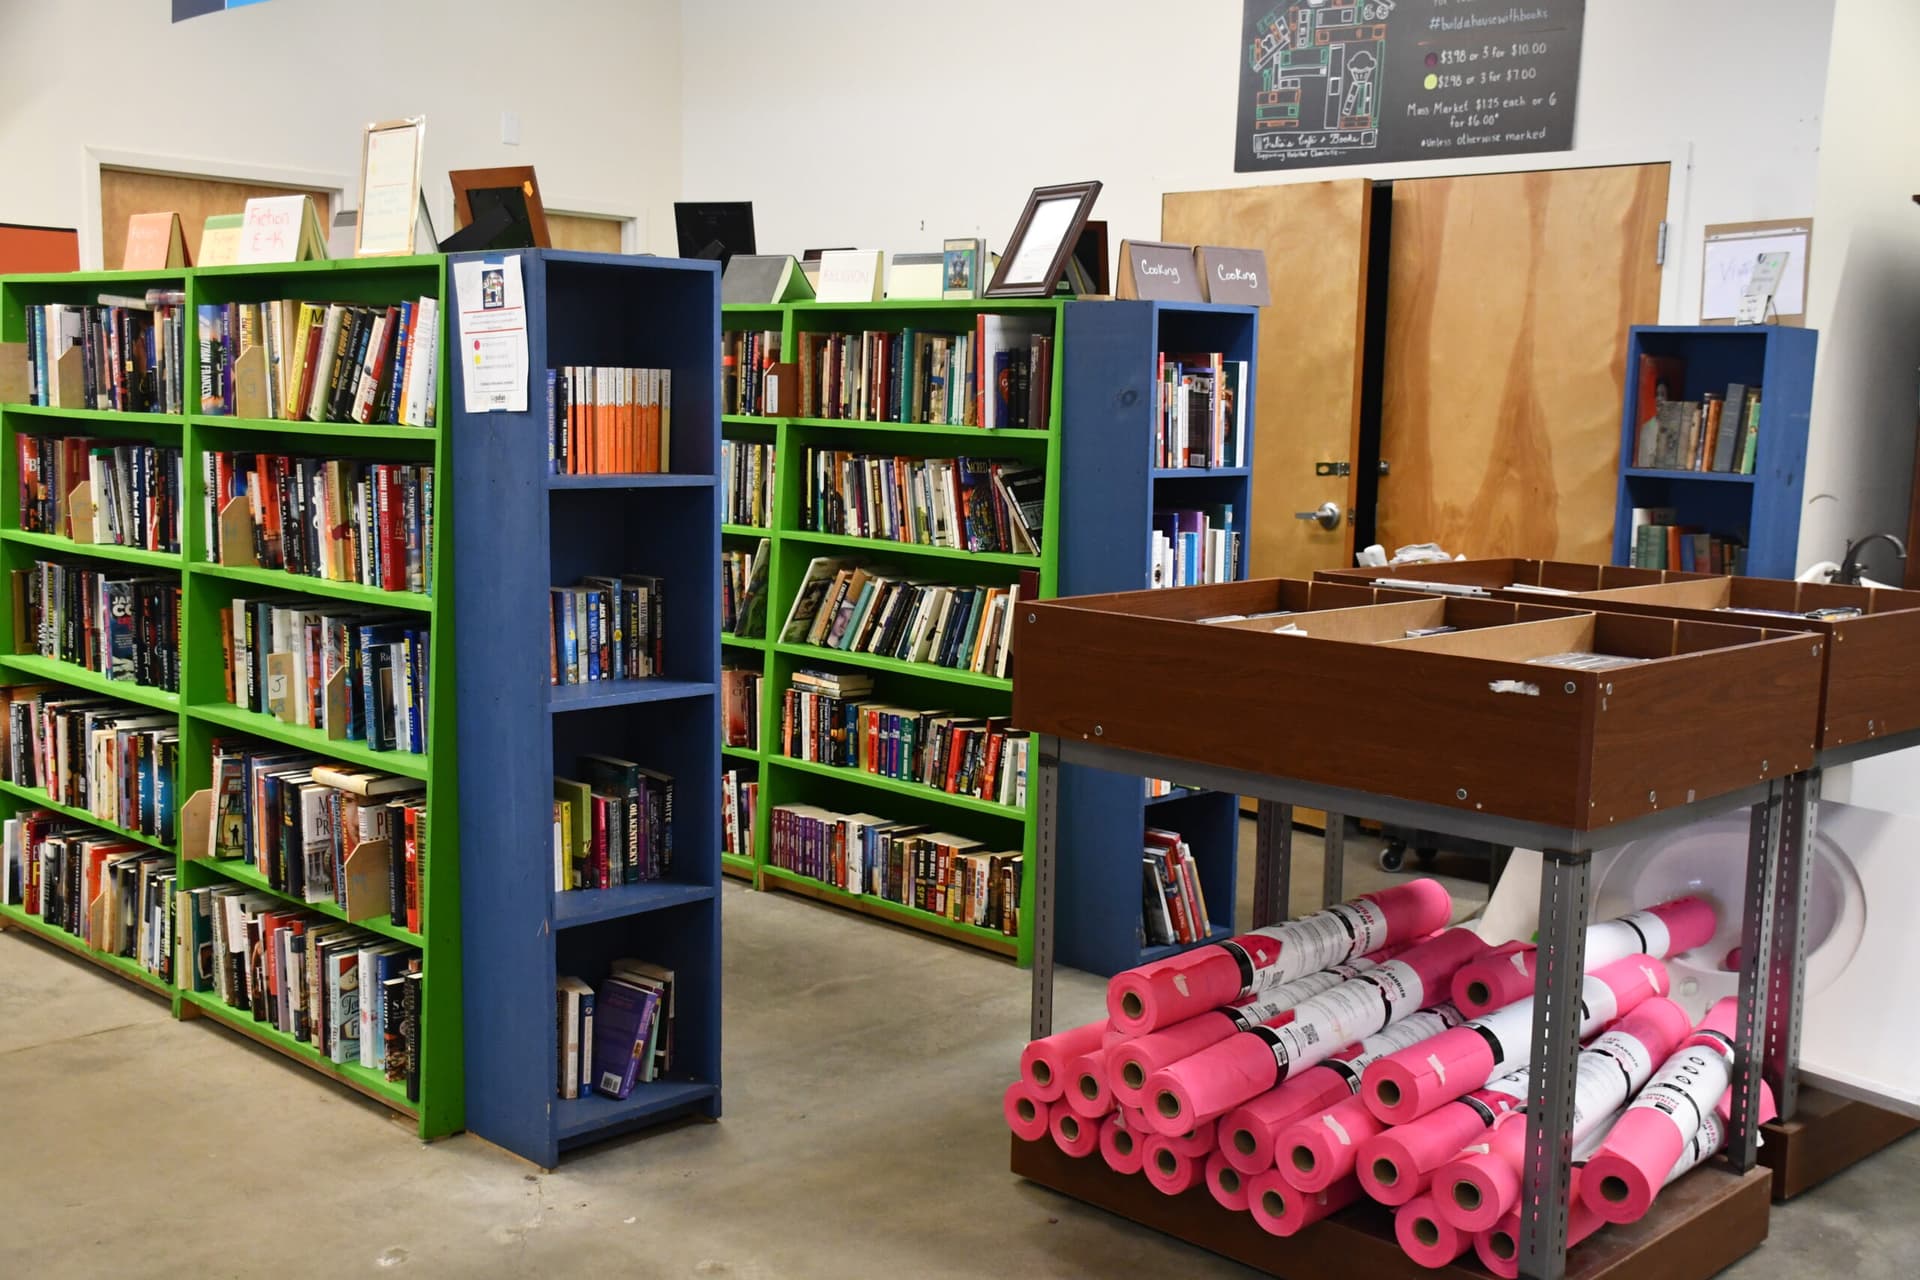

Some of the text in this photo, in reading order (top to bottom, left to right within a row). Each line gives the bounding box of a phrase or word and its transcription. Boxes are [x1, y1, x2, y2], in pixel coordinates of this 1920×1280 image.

[1480, 72, 1487, 84] 3
[1141, 259, 1181, 285] Cooking
[1217, 264, 1258, 288] Cooking
[629, 818, 638, 866] KENTUCKY!
[917, 886, 925, 905] SPY
